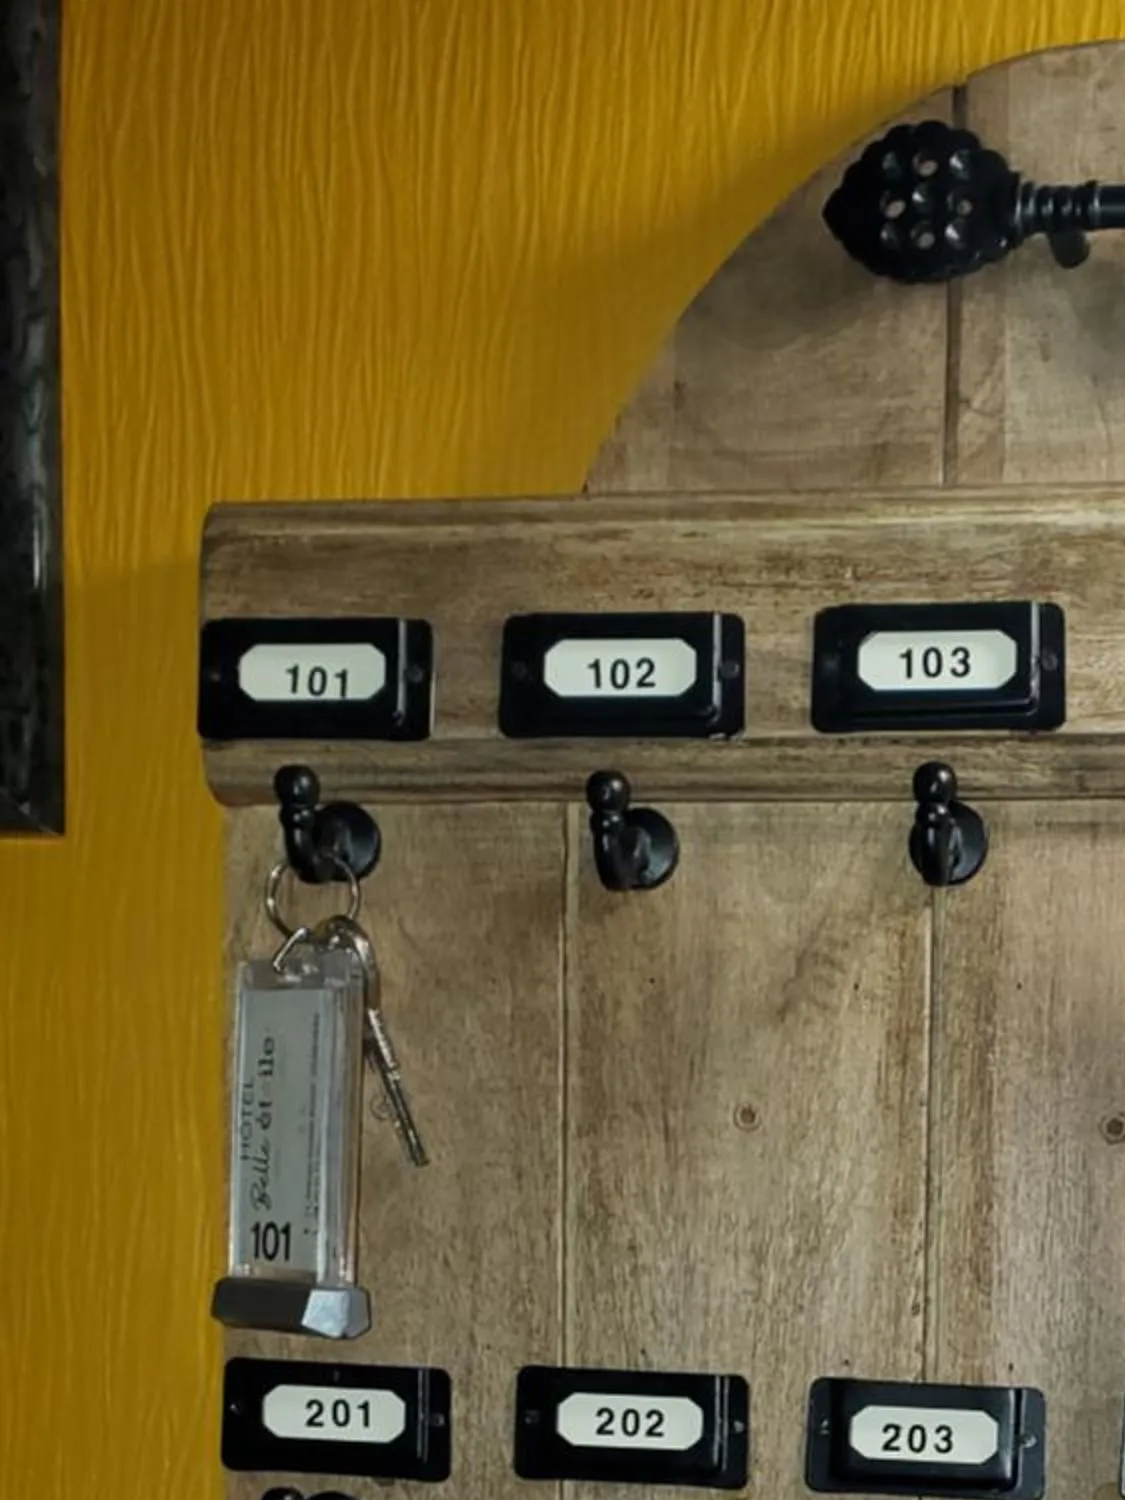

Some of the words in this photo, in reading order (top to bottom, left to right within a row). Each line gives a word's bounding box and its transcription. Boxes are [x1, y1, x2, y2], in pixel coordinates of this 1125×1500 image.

[589, 658, 655, 689] 102
[900, 647, 970, 678] 103
[286, 665, 352, 699] 101
[256, 1037, 275, 1130] étile
[251, 1221, 291, 1262] 101
[306, 1399, 369, 1427] 201
[596, 1408, 664, 1437] 202
[882, 1424, 952, 1453] 203
